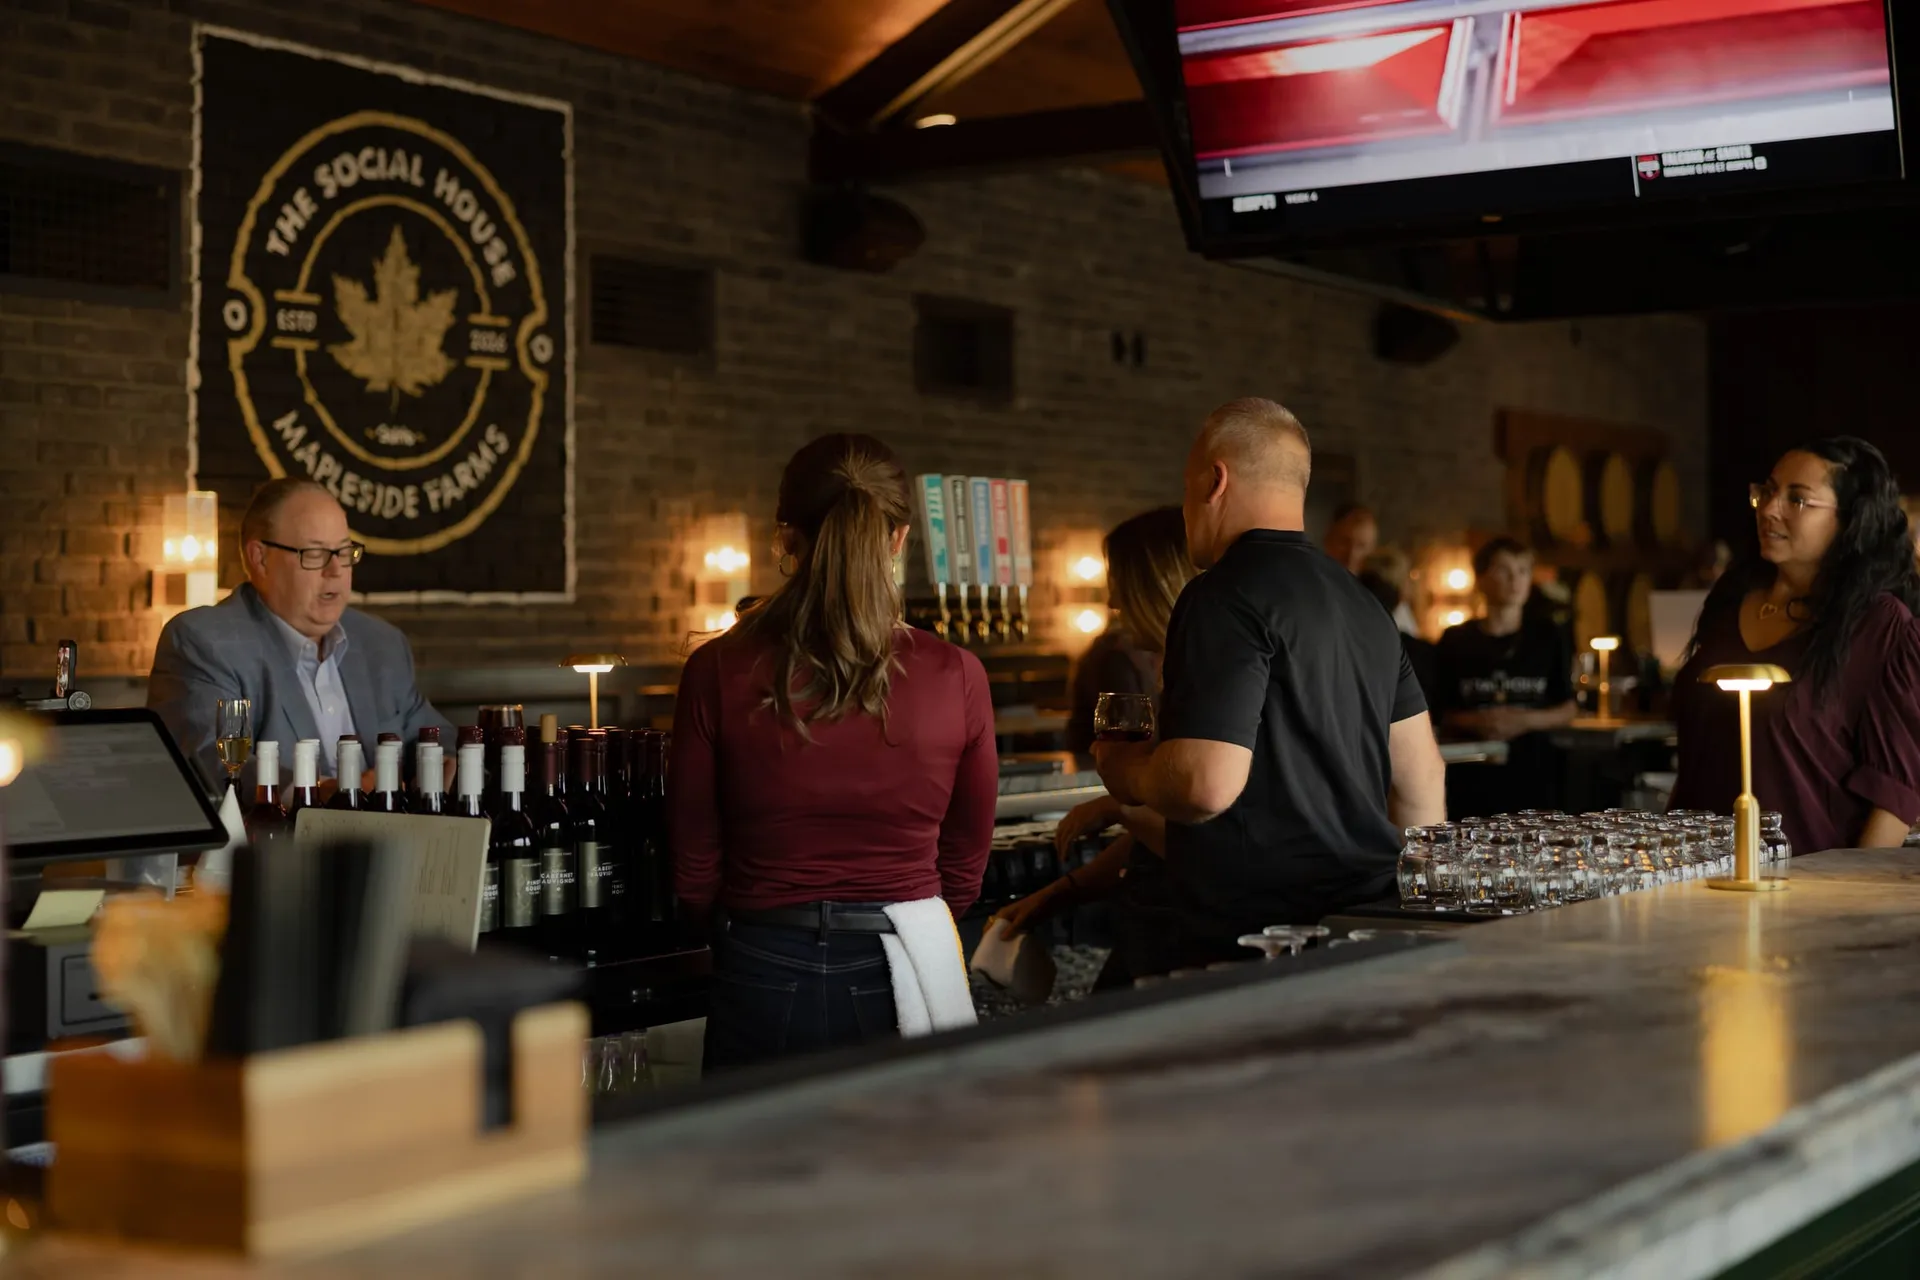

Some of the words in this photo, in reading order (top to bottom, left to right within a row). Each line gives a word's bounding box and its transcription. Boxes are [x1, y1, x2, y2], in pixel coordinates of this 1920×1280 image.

[266, 187, 319, 256] THE
[314, 146, 425, 199] SOCIAL
[434, 167, 517, 287] HOUSE
[273, 410, 420, 519] MAPLESIDE
[423, 423, 510, 512] FARMS
